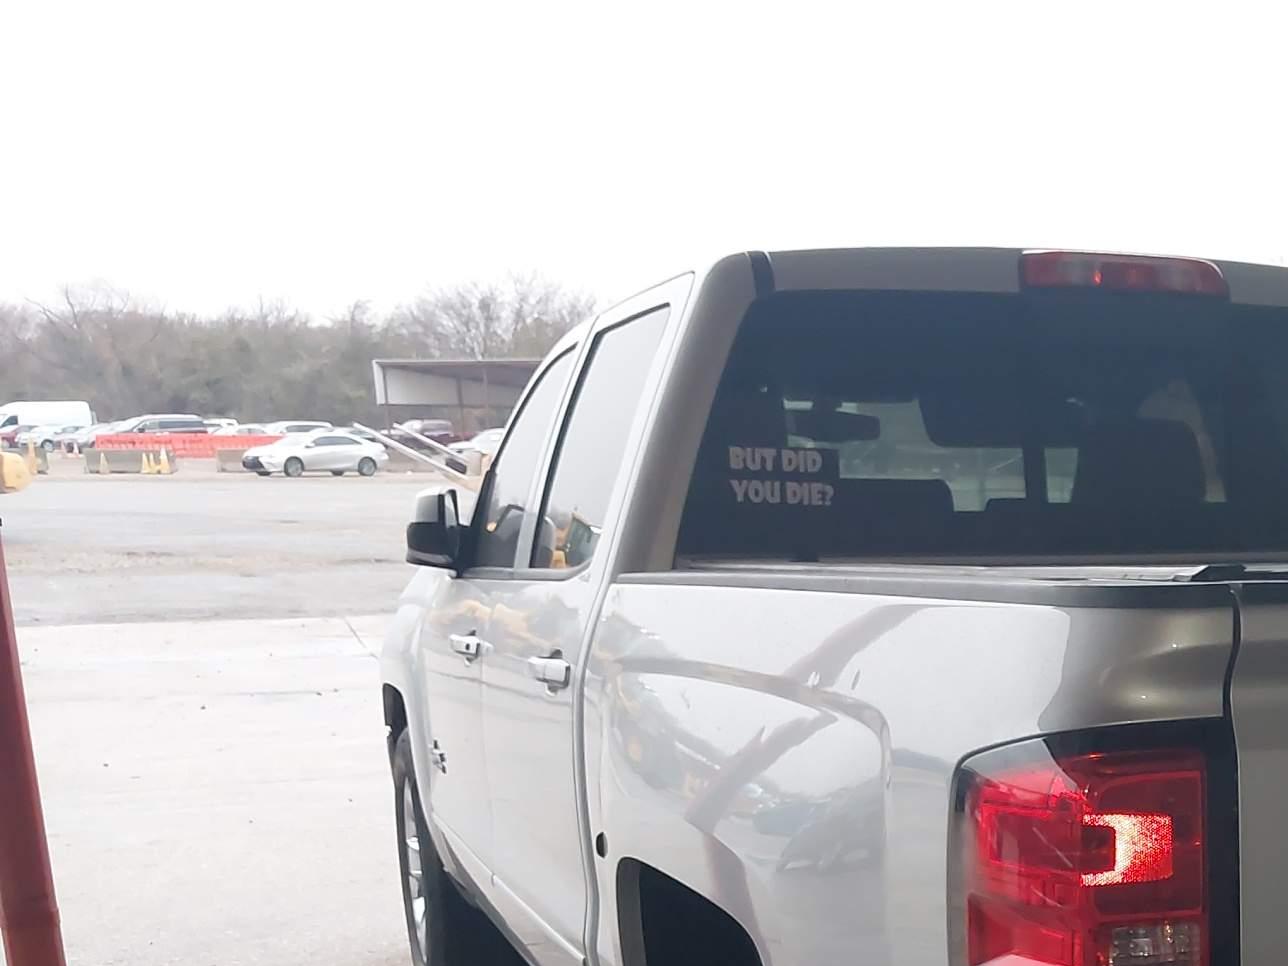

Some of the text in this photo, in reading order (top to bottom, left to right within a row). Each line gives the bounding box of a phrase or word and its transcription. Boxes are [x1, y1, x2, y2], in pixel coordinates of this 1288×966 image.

[729, 446, 823, 473] BUT DID
[730, 479, 834, 506] YOU DIE?
